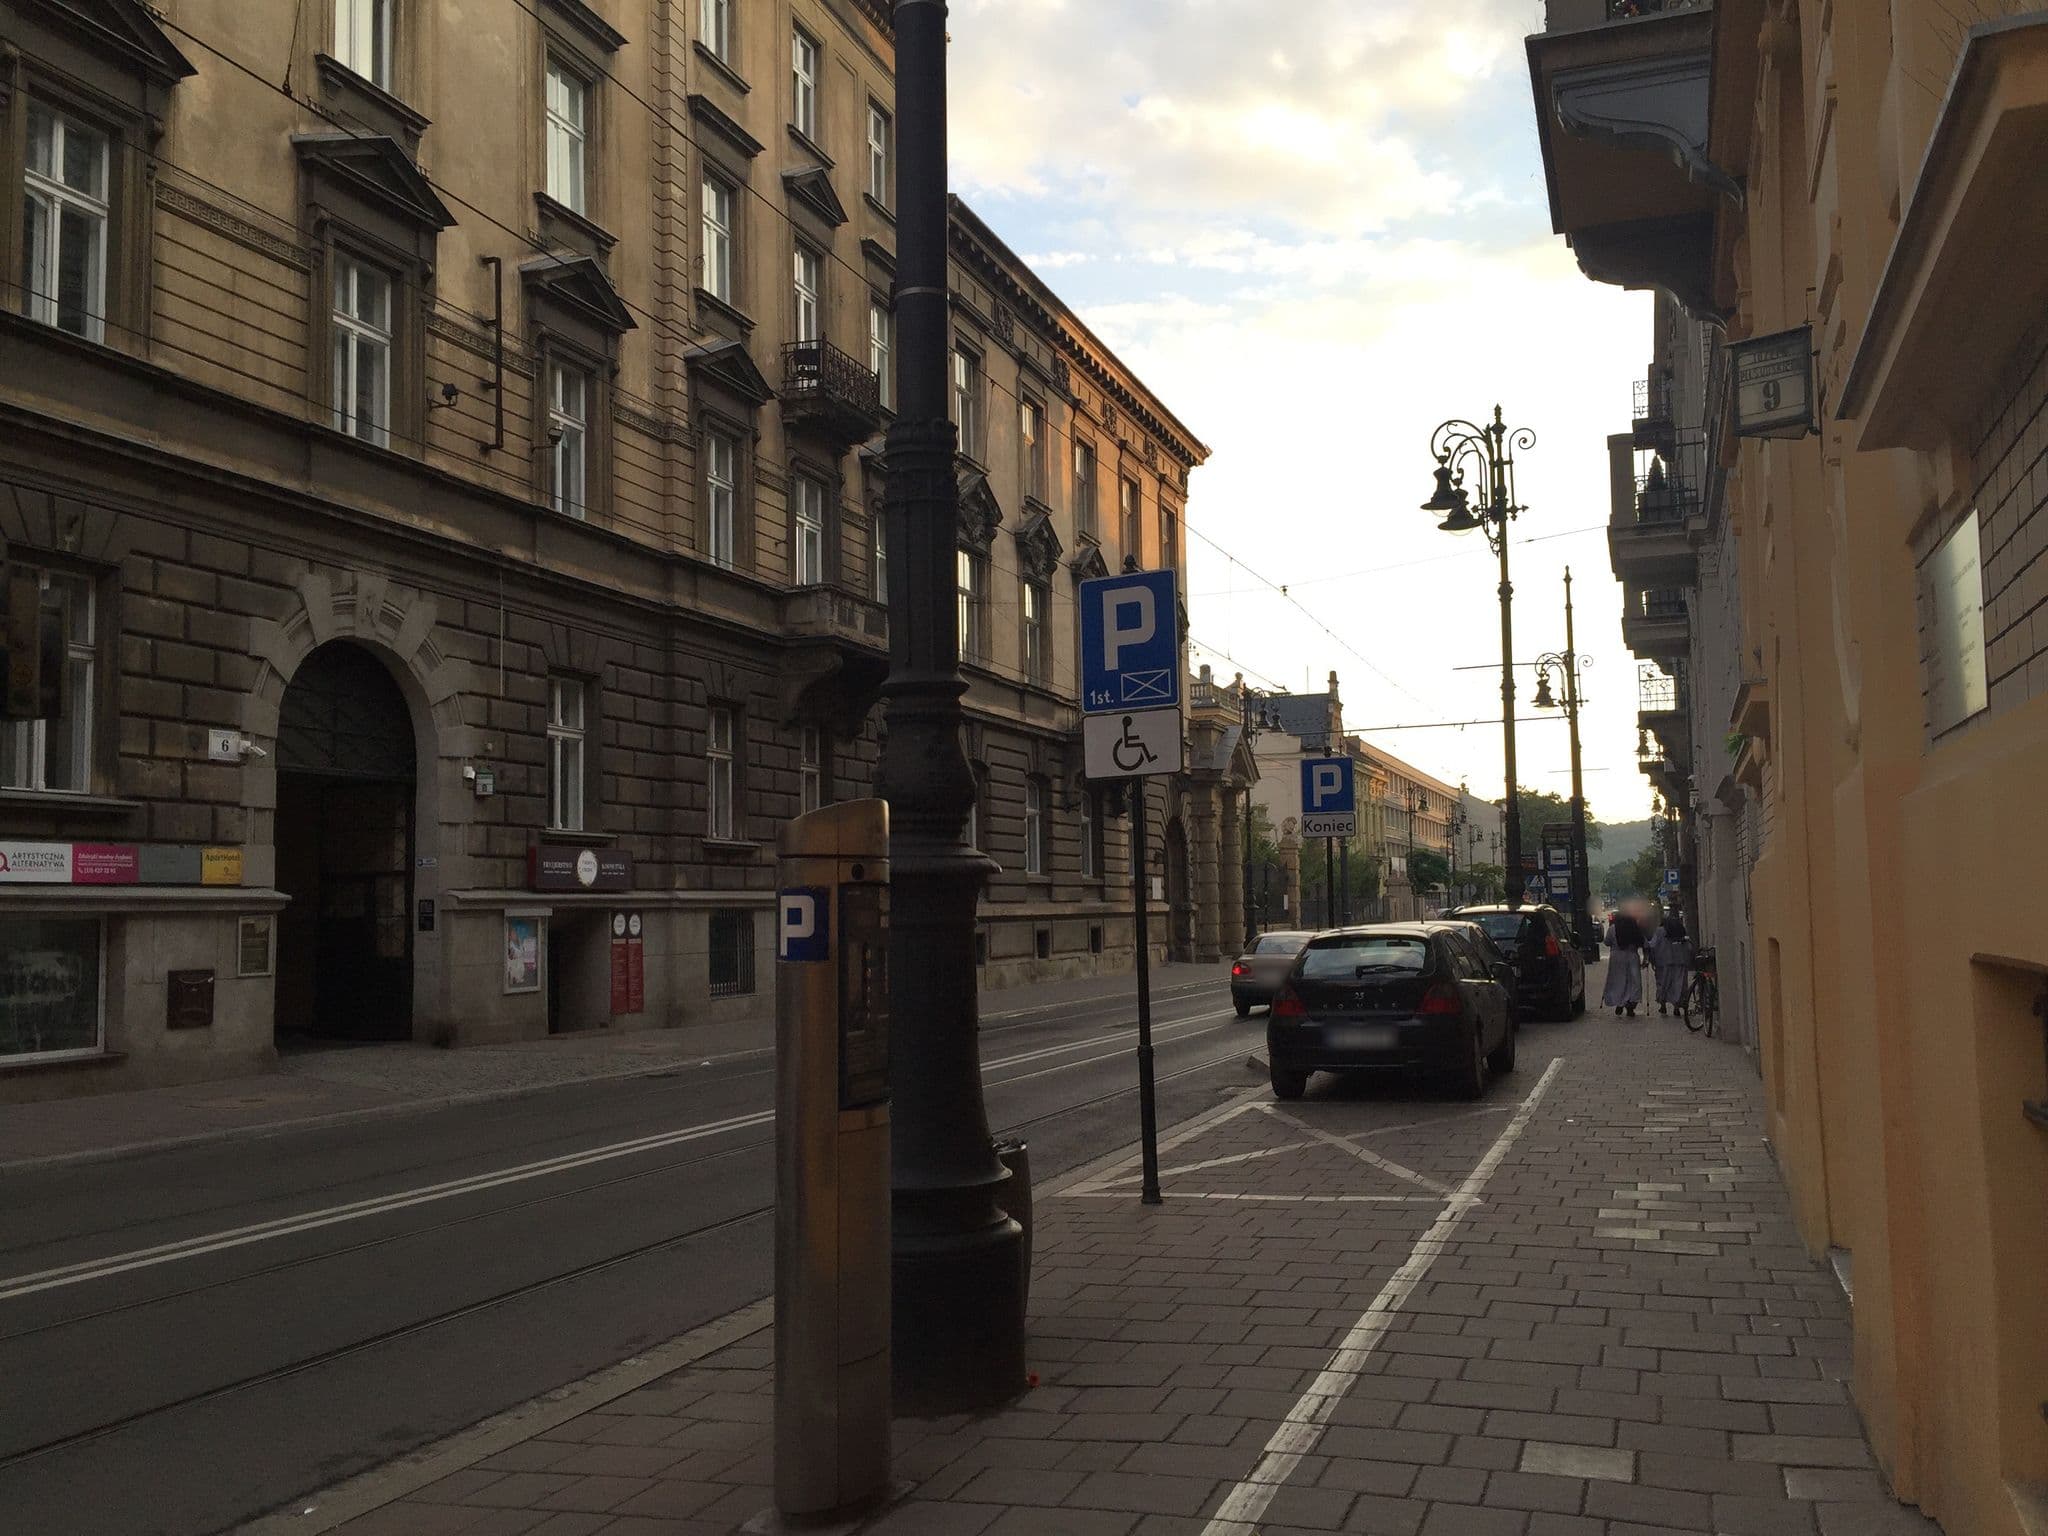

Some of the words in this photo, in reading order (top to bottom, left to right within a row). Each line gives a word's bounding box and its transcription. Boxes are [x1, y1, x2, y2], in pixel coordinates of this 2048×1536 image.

[1762, 380, 1781, 411] 9
[1102, 585, 1156, 672] P
[1090, 689, 1114, 706] 1st.
[221, 739, 229, 752] 6
[1312, 764, 1343, 808] P
[1303, 819, 1353, 834] Koniec
[12, 852, 65, 861] ARTYSTYCZNA
[12, 860, 65, 868] ALTERNATYWA
[1668, 871, 1678, 884] P
[780, 895, 815, 958] P
